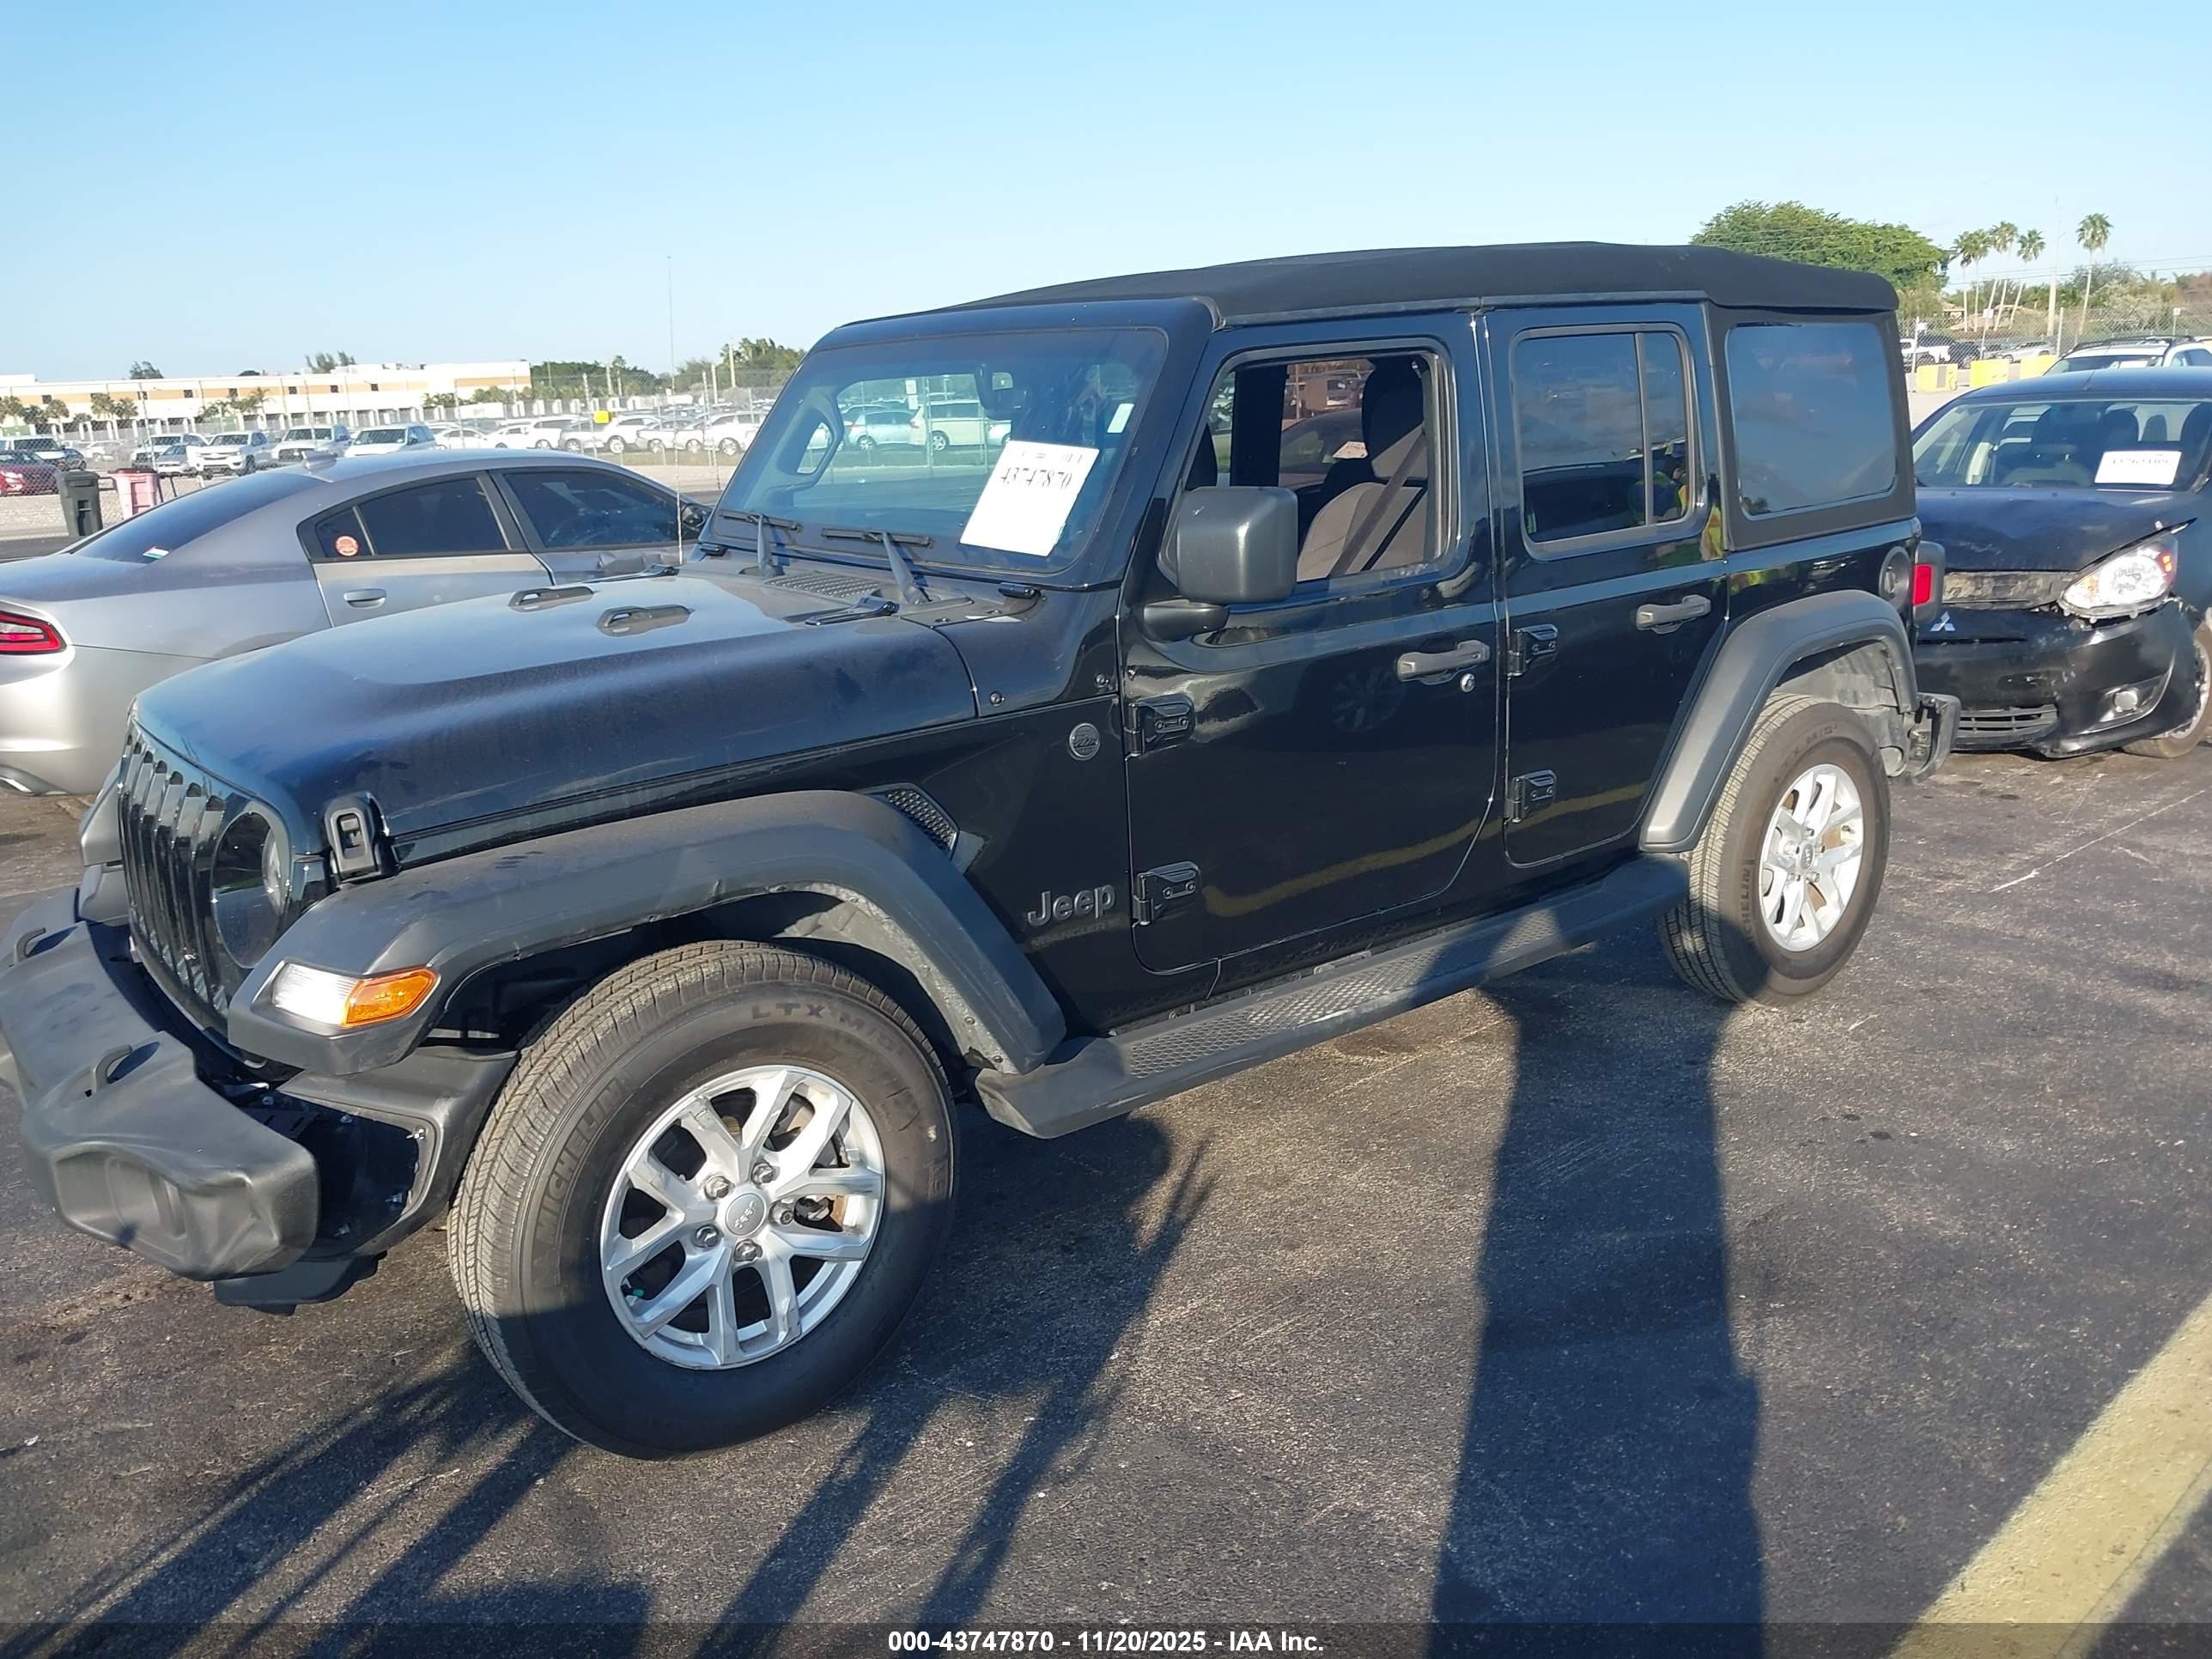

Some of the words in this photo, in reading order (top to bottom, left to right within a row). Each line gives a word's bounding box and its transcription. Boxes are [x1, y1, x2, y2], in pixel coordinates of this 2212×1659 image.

[1000, 466, 1073, 489] 43747870
[1027, 884, 1115, 927] Jeep
[751, 1002, 826, 1019] LTX
[534, 1071, 634, 1246] MICHELIN
